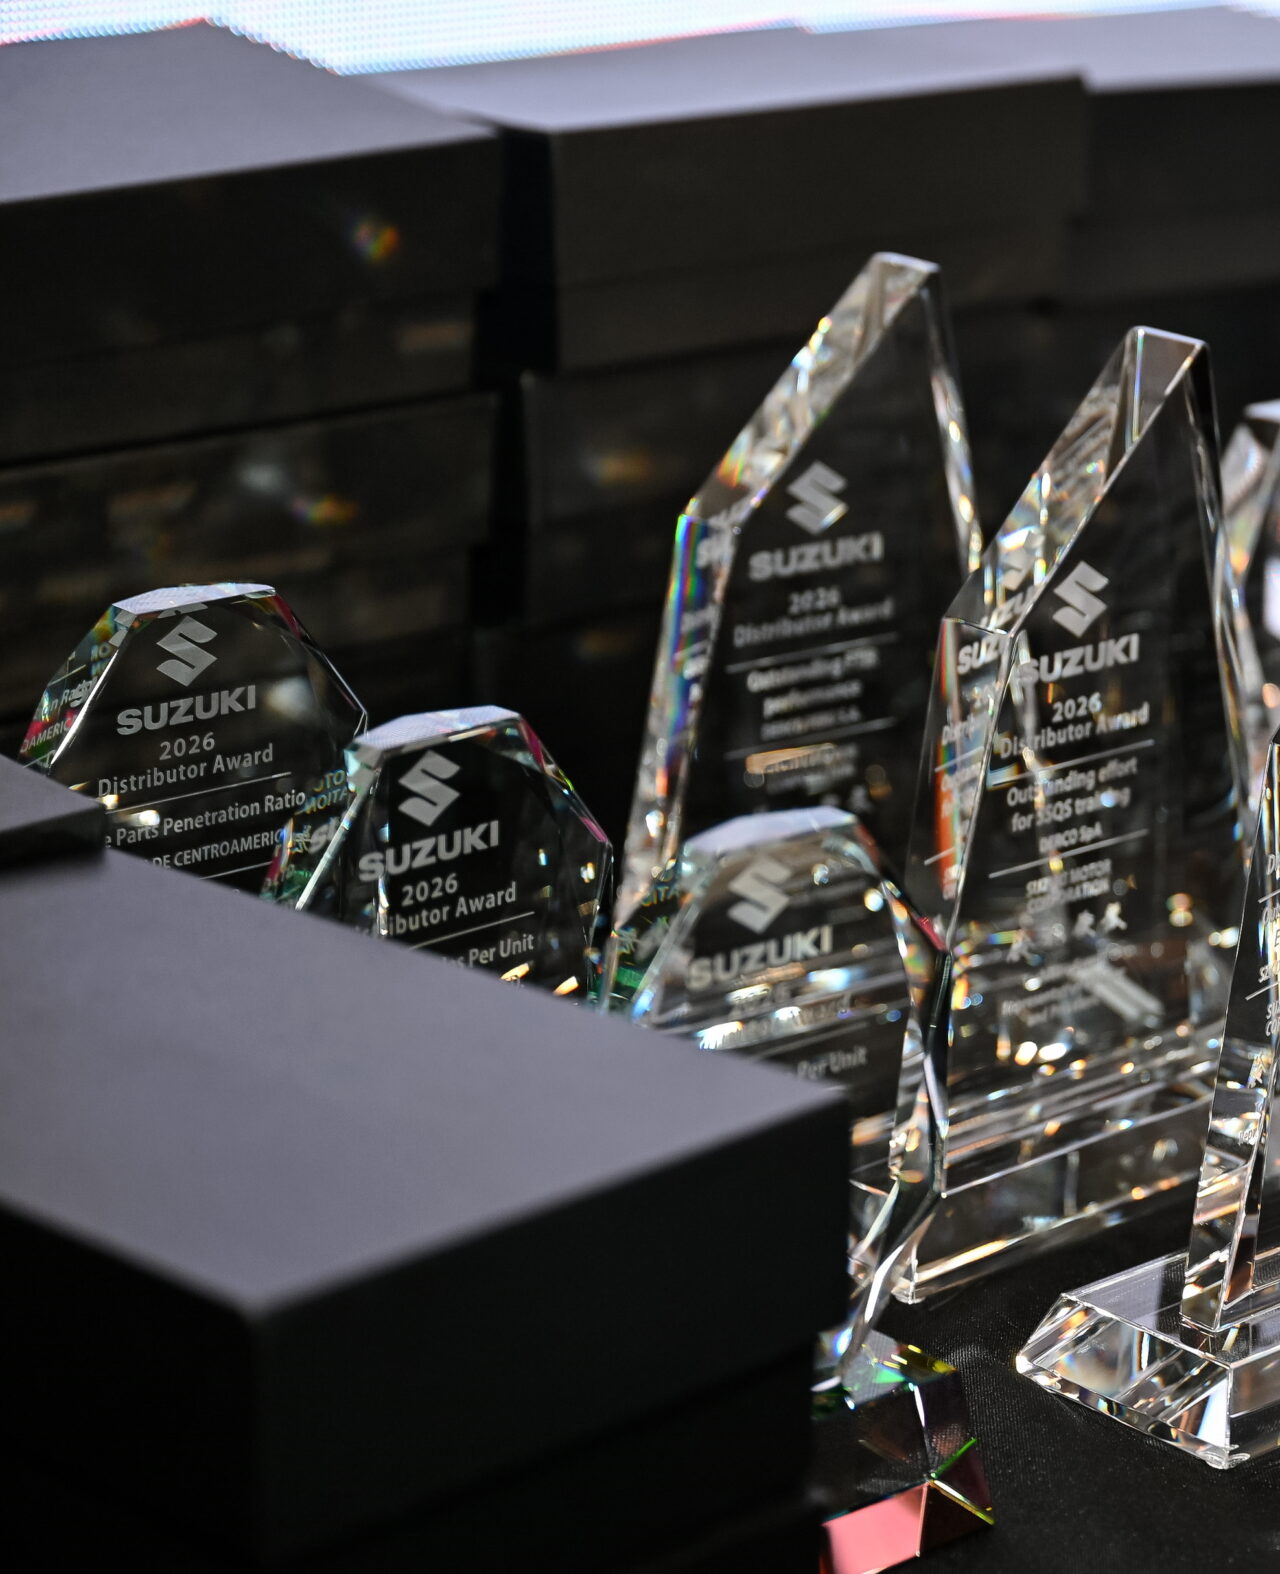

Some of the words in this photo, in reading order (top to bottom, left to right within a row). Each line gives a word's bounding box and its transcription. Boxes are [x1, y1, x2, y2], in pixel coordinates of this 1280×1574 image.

[750, 532, 885, 582] SUZUKI
[1018, 633, 1139, 683] SUZUKI
[117, 685, 256, 735] SUZUKI
[1052, 692, 1102, 723] 2026
[159, 732, 215, 761] 2026
[98, 761, 206, 797] Distributor
[212, 744, 274, 773] Award
[116, 825, 159, 846] Parts
[163, 801, 260, 836] Penetration
[265, 789, 306, 813] Ratio
[1011, 812, 1034, 832] for
[174, 828, 284, 867] CENTROAMERIC
[358, 820, 499, 882] SUZUKI
[401, 873, 458, 906] 2026
[455, 881, 517, 917] Award
[469, 948, 496, 967] Per
[500, 934, 534, 957] Unit
[687, 926, 833, 991] SUZUKI
